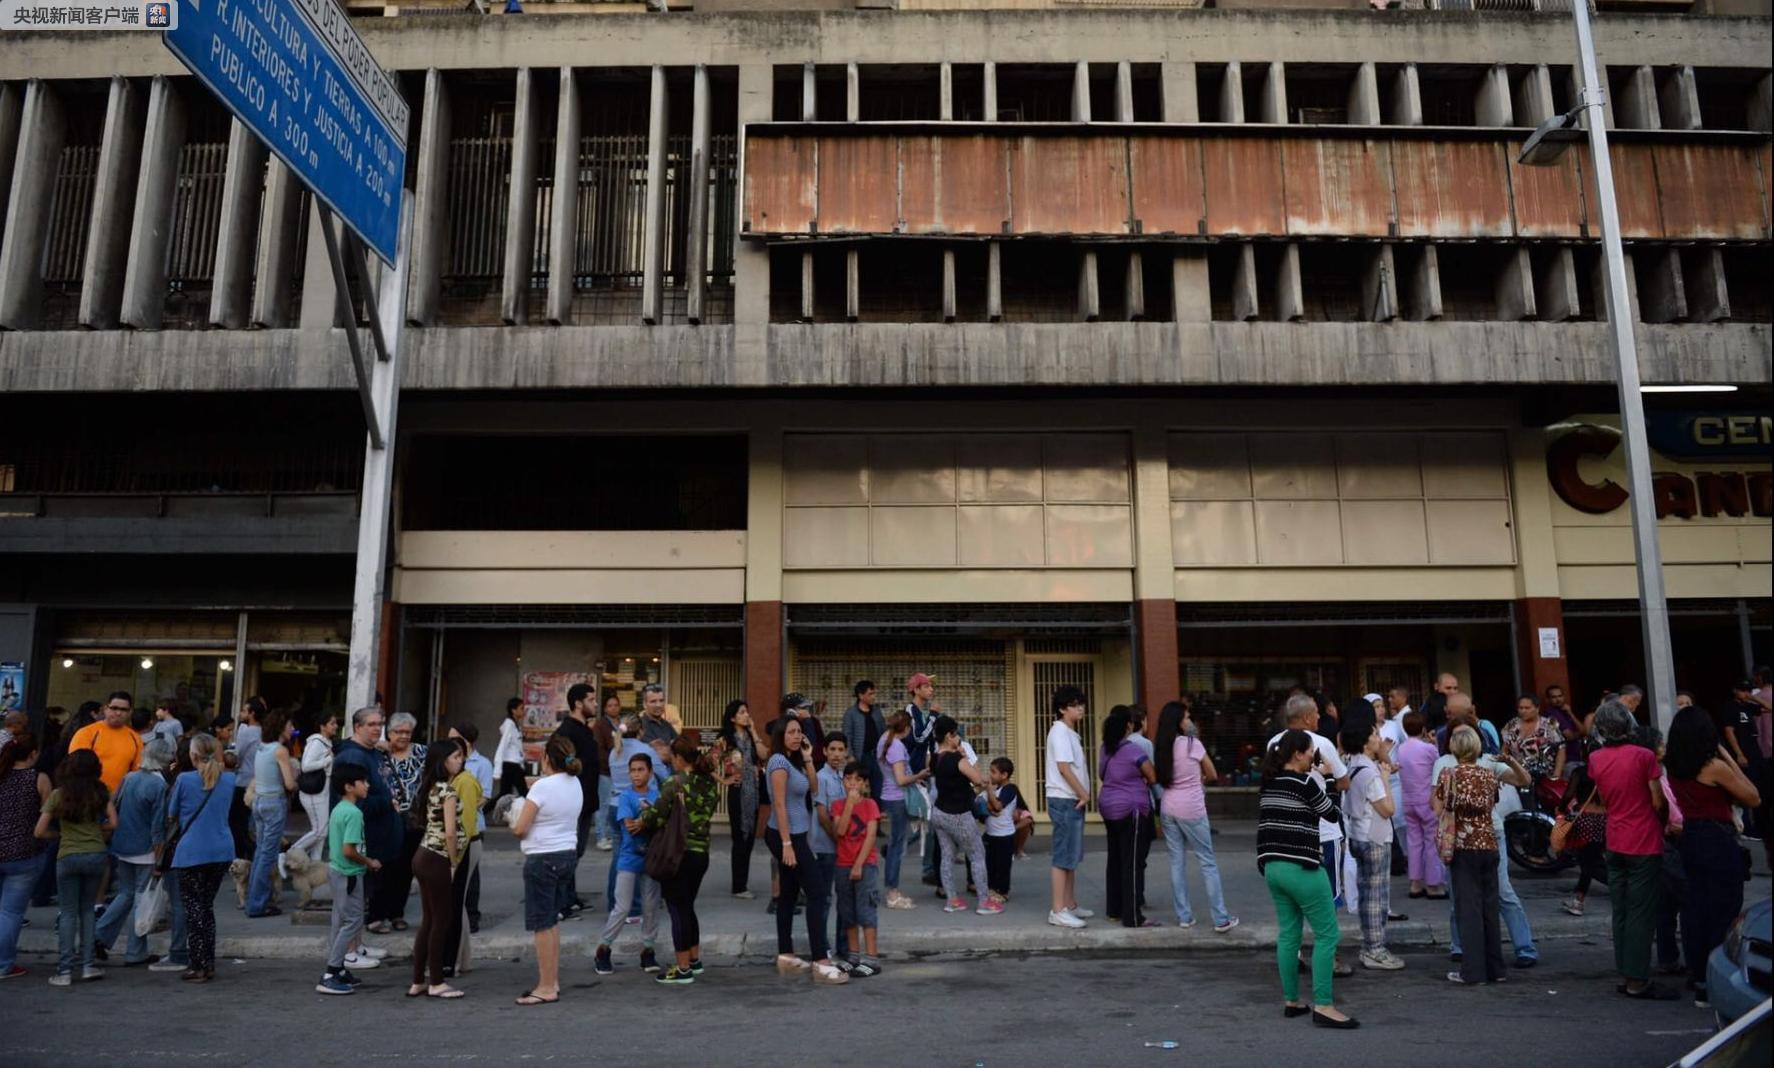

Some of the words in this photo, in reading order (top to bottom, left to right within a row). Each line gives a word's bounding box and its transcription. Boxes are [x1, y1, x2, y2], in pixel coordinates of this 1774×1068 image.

[211, 33, 265, 112] PUBLICO
[268, 99, 277, 129] A
[284, 115, 308, 157] 300
[309, 149, 319, 170] m
[232, 5, 300, 103] INTERIORES
[304, 87, 312, 115] Y
[314, 104, 353, 168] JUSTICIA
[355, 152, 363, 177] A
[366, 164, 383, 198] 200
[313, 54, 321, 81] Y
[324, 70, 362, 136] TIERRAS
[364, 124, 372, 149] A
[373, 133, 388, 167] 100
[323, 0, 340, 45] DEL
[342, 27, 370, 88] PODER
[371, 70, 407, 131] POPULAR
